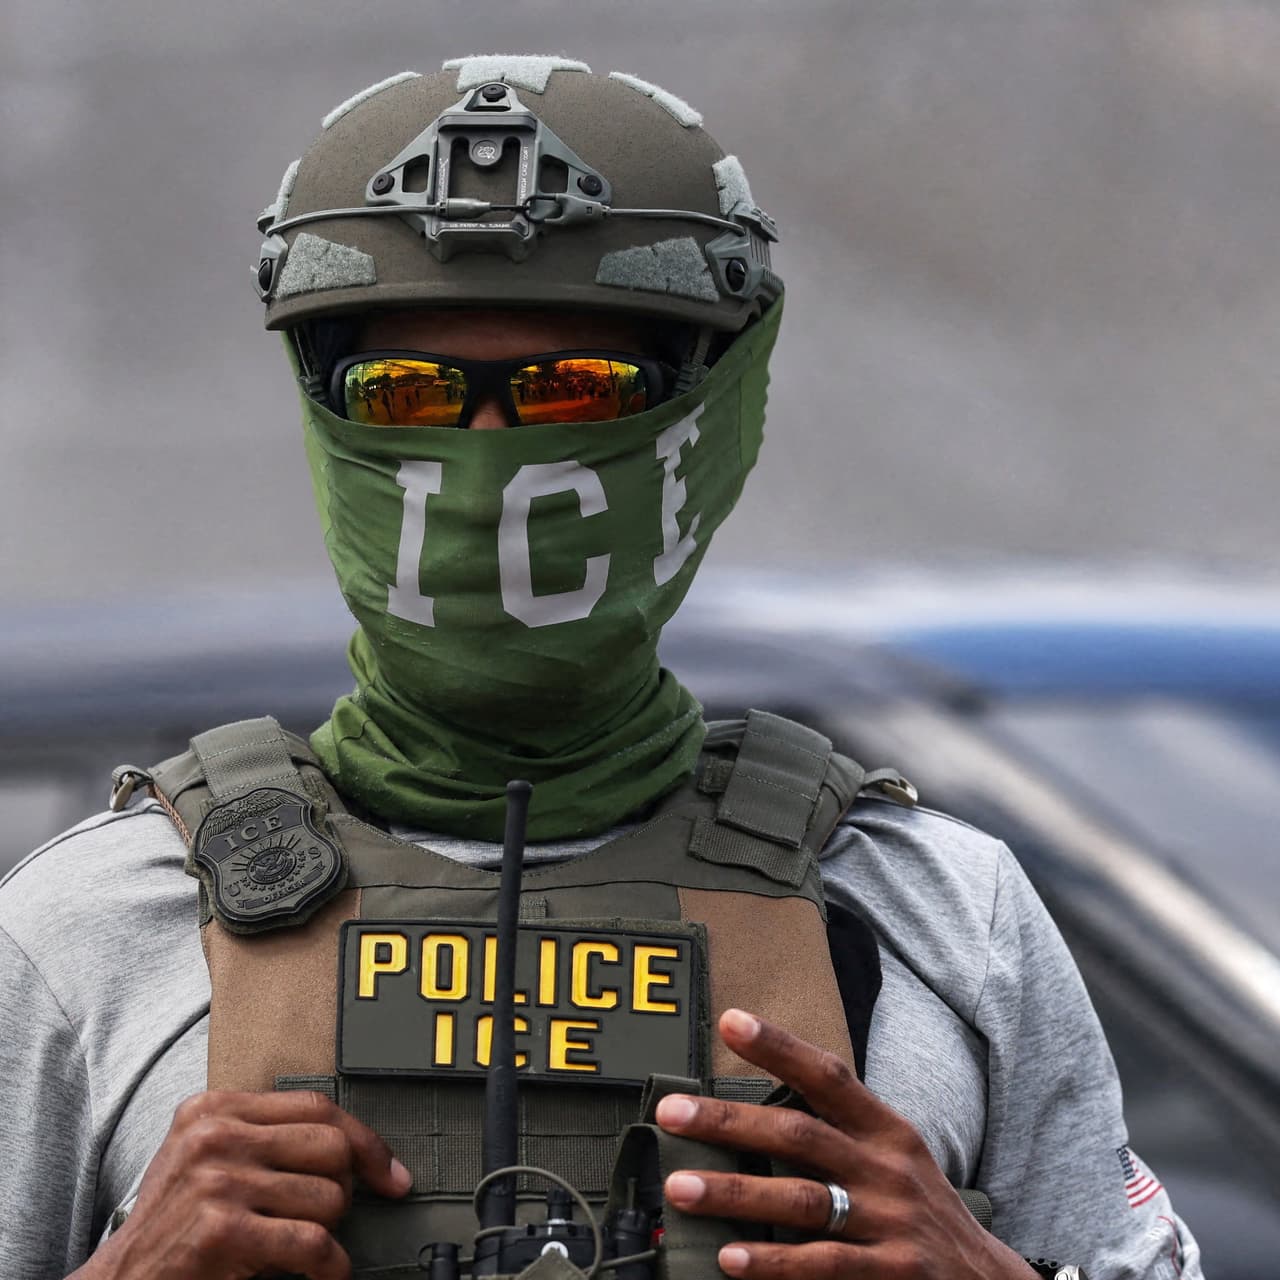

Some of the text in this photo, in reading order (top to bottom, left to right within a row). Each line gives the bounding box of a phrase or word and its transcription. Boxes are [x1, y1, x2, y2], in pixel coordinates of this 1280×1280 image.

[387, 403, 705, 628] ICE
[226, 817, 282, 850] ICE
[355, 931, 680, 1014] POLICE
[430, 1011, 600, 1073] ICE
